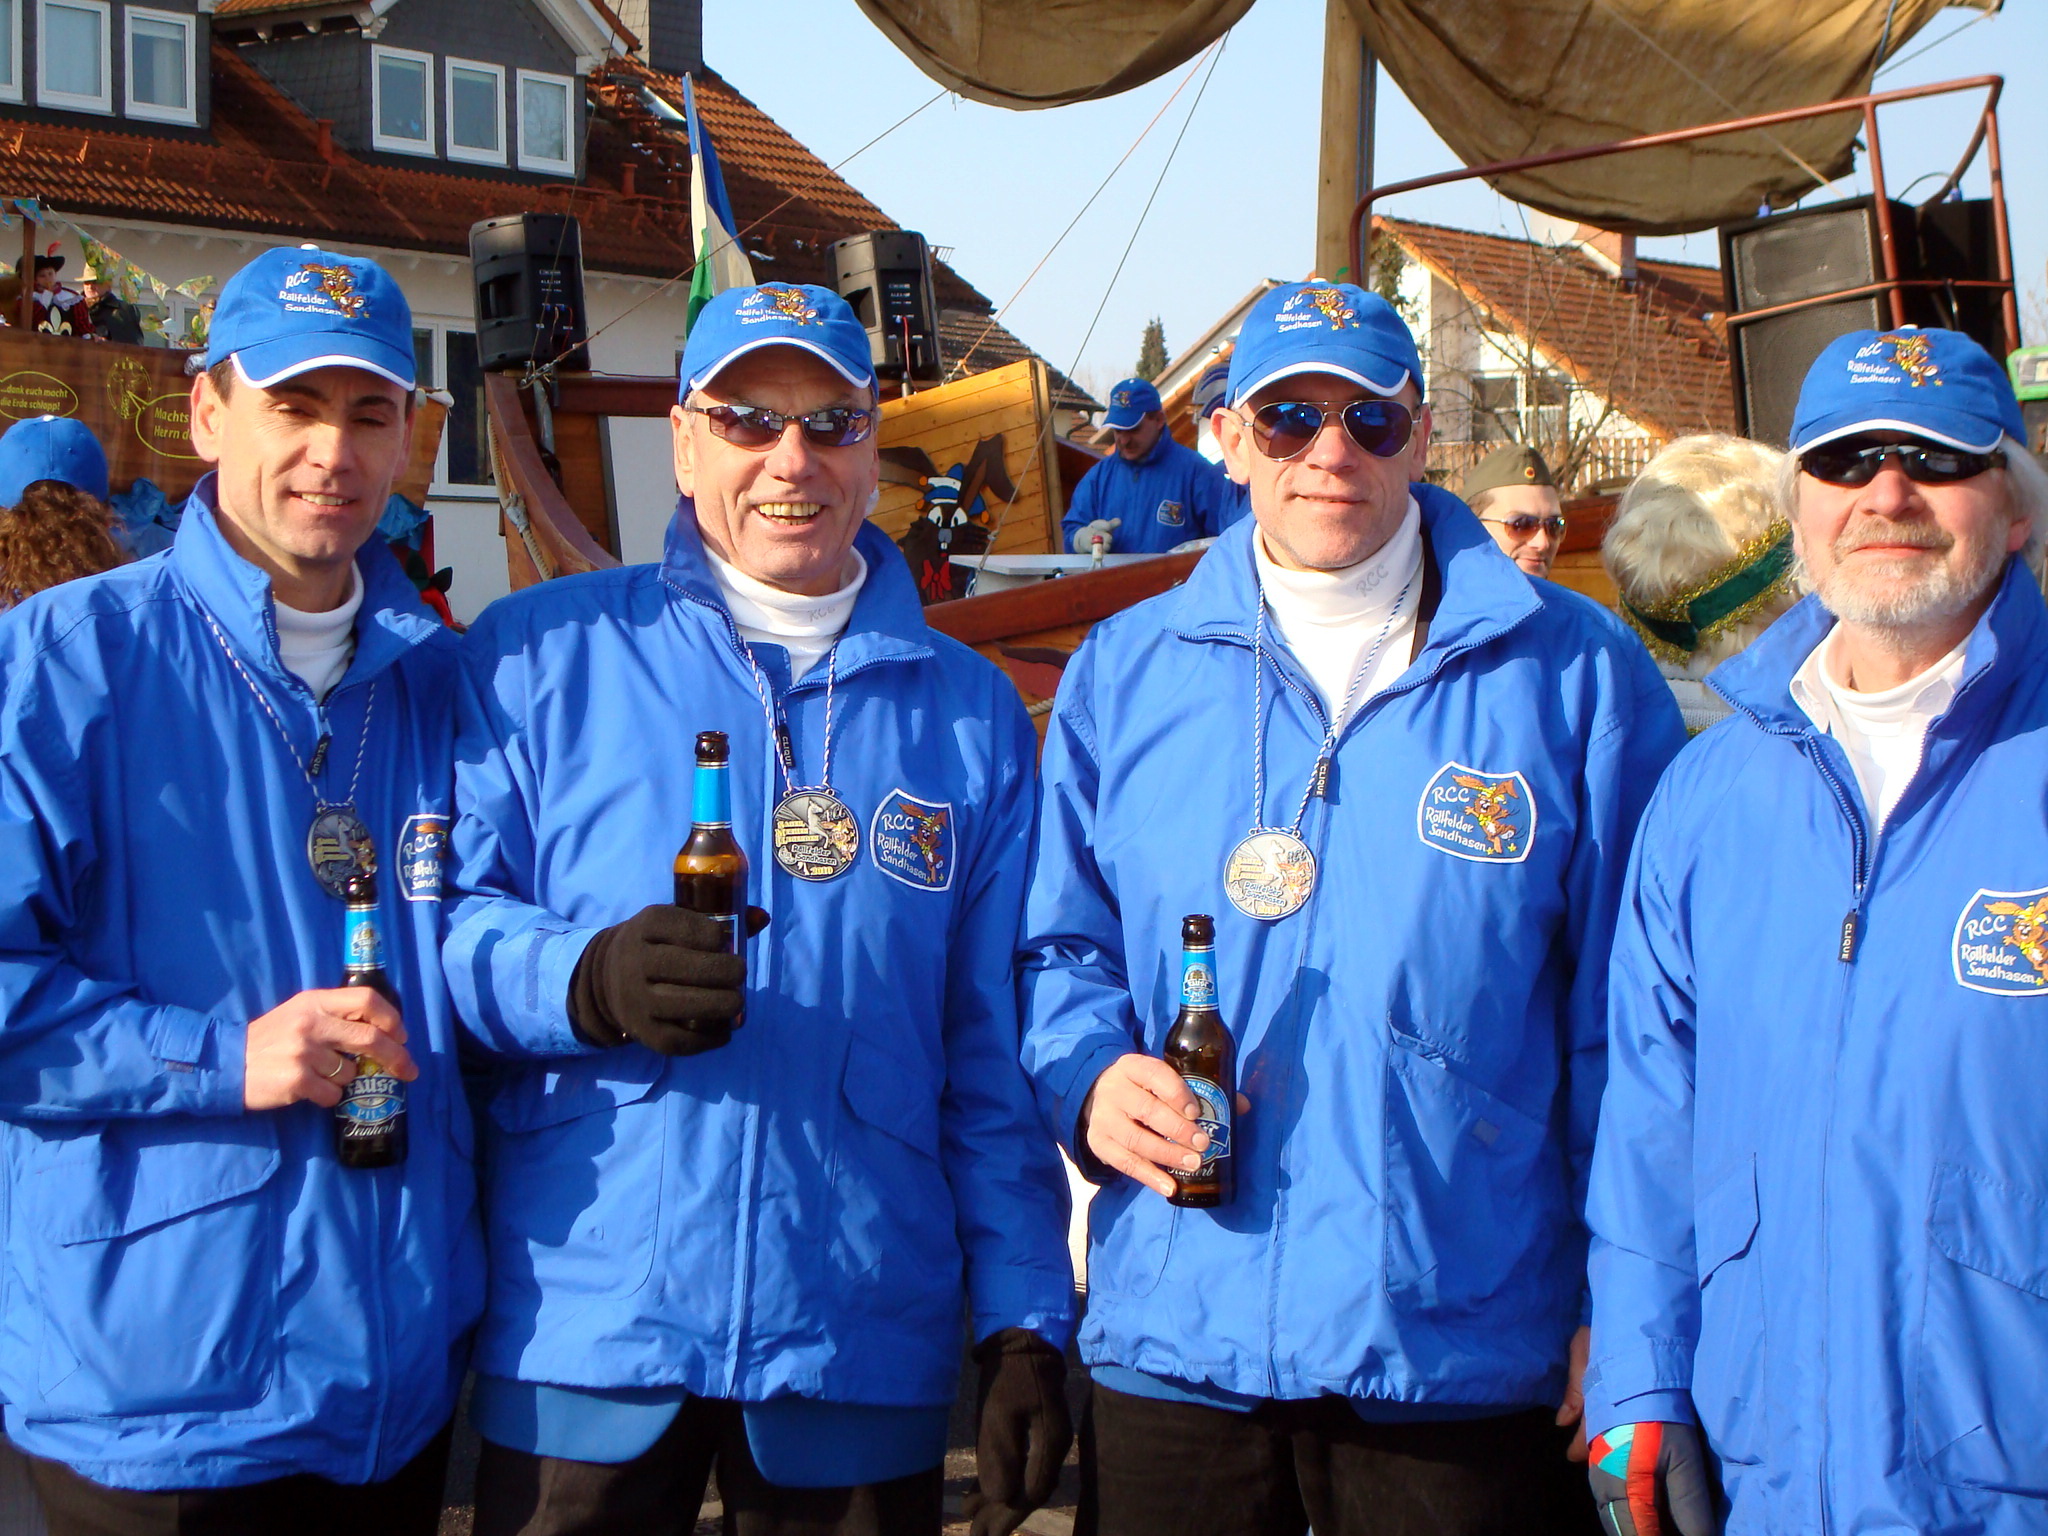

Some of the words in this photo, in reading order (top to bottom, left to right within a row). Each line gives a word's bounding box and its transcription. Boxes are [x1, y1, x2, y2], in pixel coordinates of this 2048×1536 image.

[285, 270, 310, 289] RCC
[742, 291, 764, 308] RCC
[1282, 293, 1304, 313] RCC
[285, 303, 342, 316] Sandhasen
[1855, 341, 1883, 359] RCC
[25, 386, 43, 396] euch
[43, 388, 68, 398] macht
[12, 398, 28, 409] Erde
[29, 399, 61, 412] schlapp!
[153, 425, 180, 440] Herrn
[1356, 563, 1389, 598] RCC
[1316, 765, 1327, 796] CLIQUE
[1432, 786, 1470, 805] RCC
[882, 813, 915, 832] RCC
[403, 832, 439, 860] RCC
[1428, 823, 1488, 852] Sandhasen
[881, 850, 927, 880] Sandhasen
[1964, 915, 2007, 941] RCC
[1841, 922, 1853, 960] CLIQUE
[1966, 961, 2036, 984] Sandhasen
[356, 1106, 388, 1120] PILS
